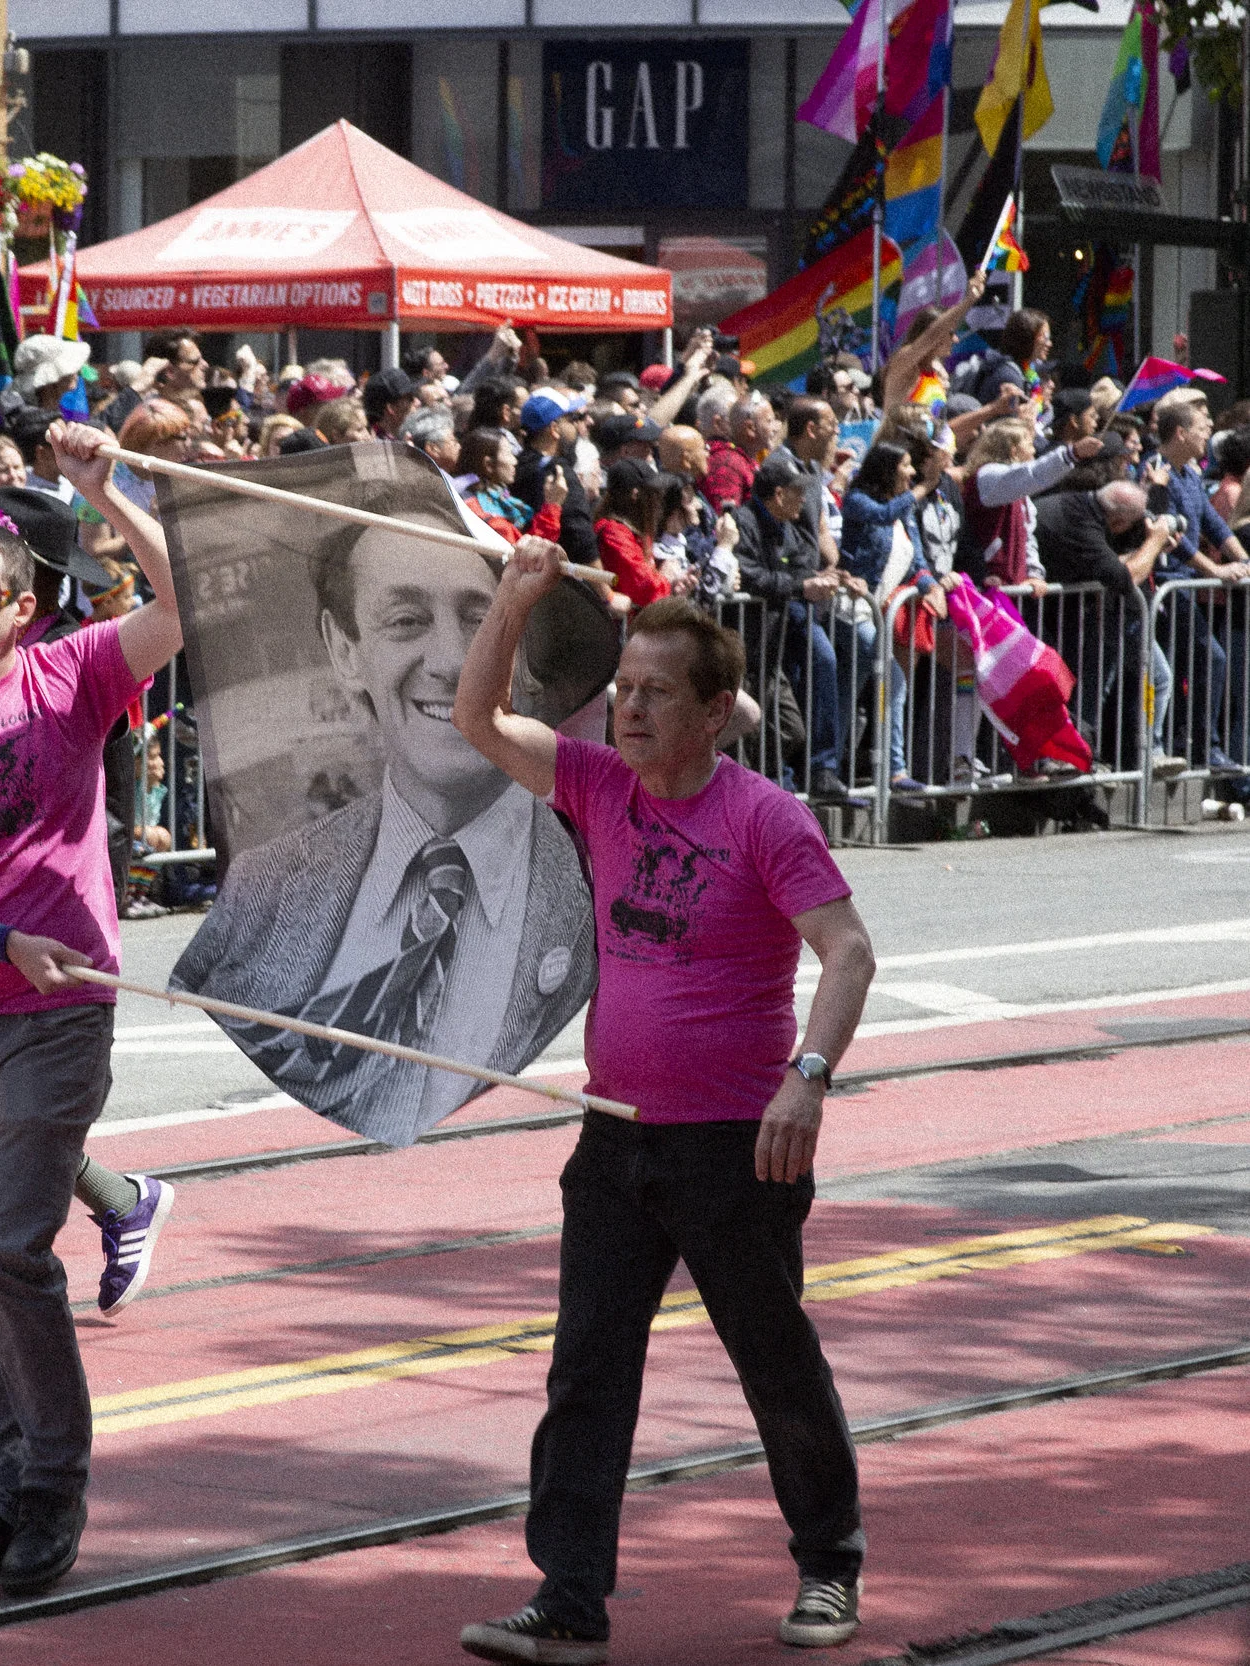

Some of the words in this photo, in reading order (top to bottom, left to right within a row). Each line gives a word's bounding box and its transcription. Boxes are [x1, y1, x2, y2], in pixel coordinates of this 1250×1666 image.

[586, 61, 703, 149] GAP
[102, 286, 175, 312] SOURCED
[192, 283, 287, 309] VEGETARIAN
[290, 281, 362, 308] OPTIONS
[402, 280, 427, 308] HOT
[429, 280, 464, 308] DOGS
[475, 282, 536, 311] PRETZELS
[547, 285, 569, 312] ICE
[569, 286, 611, 313] CREAM
[622, 288, 668, 315] DRINKS
